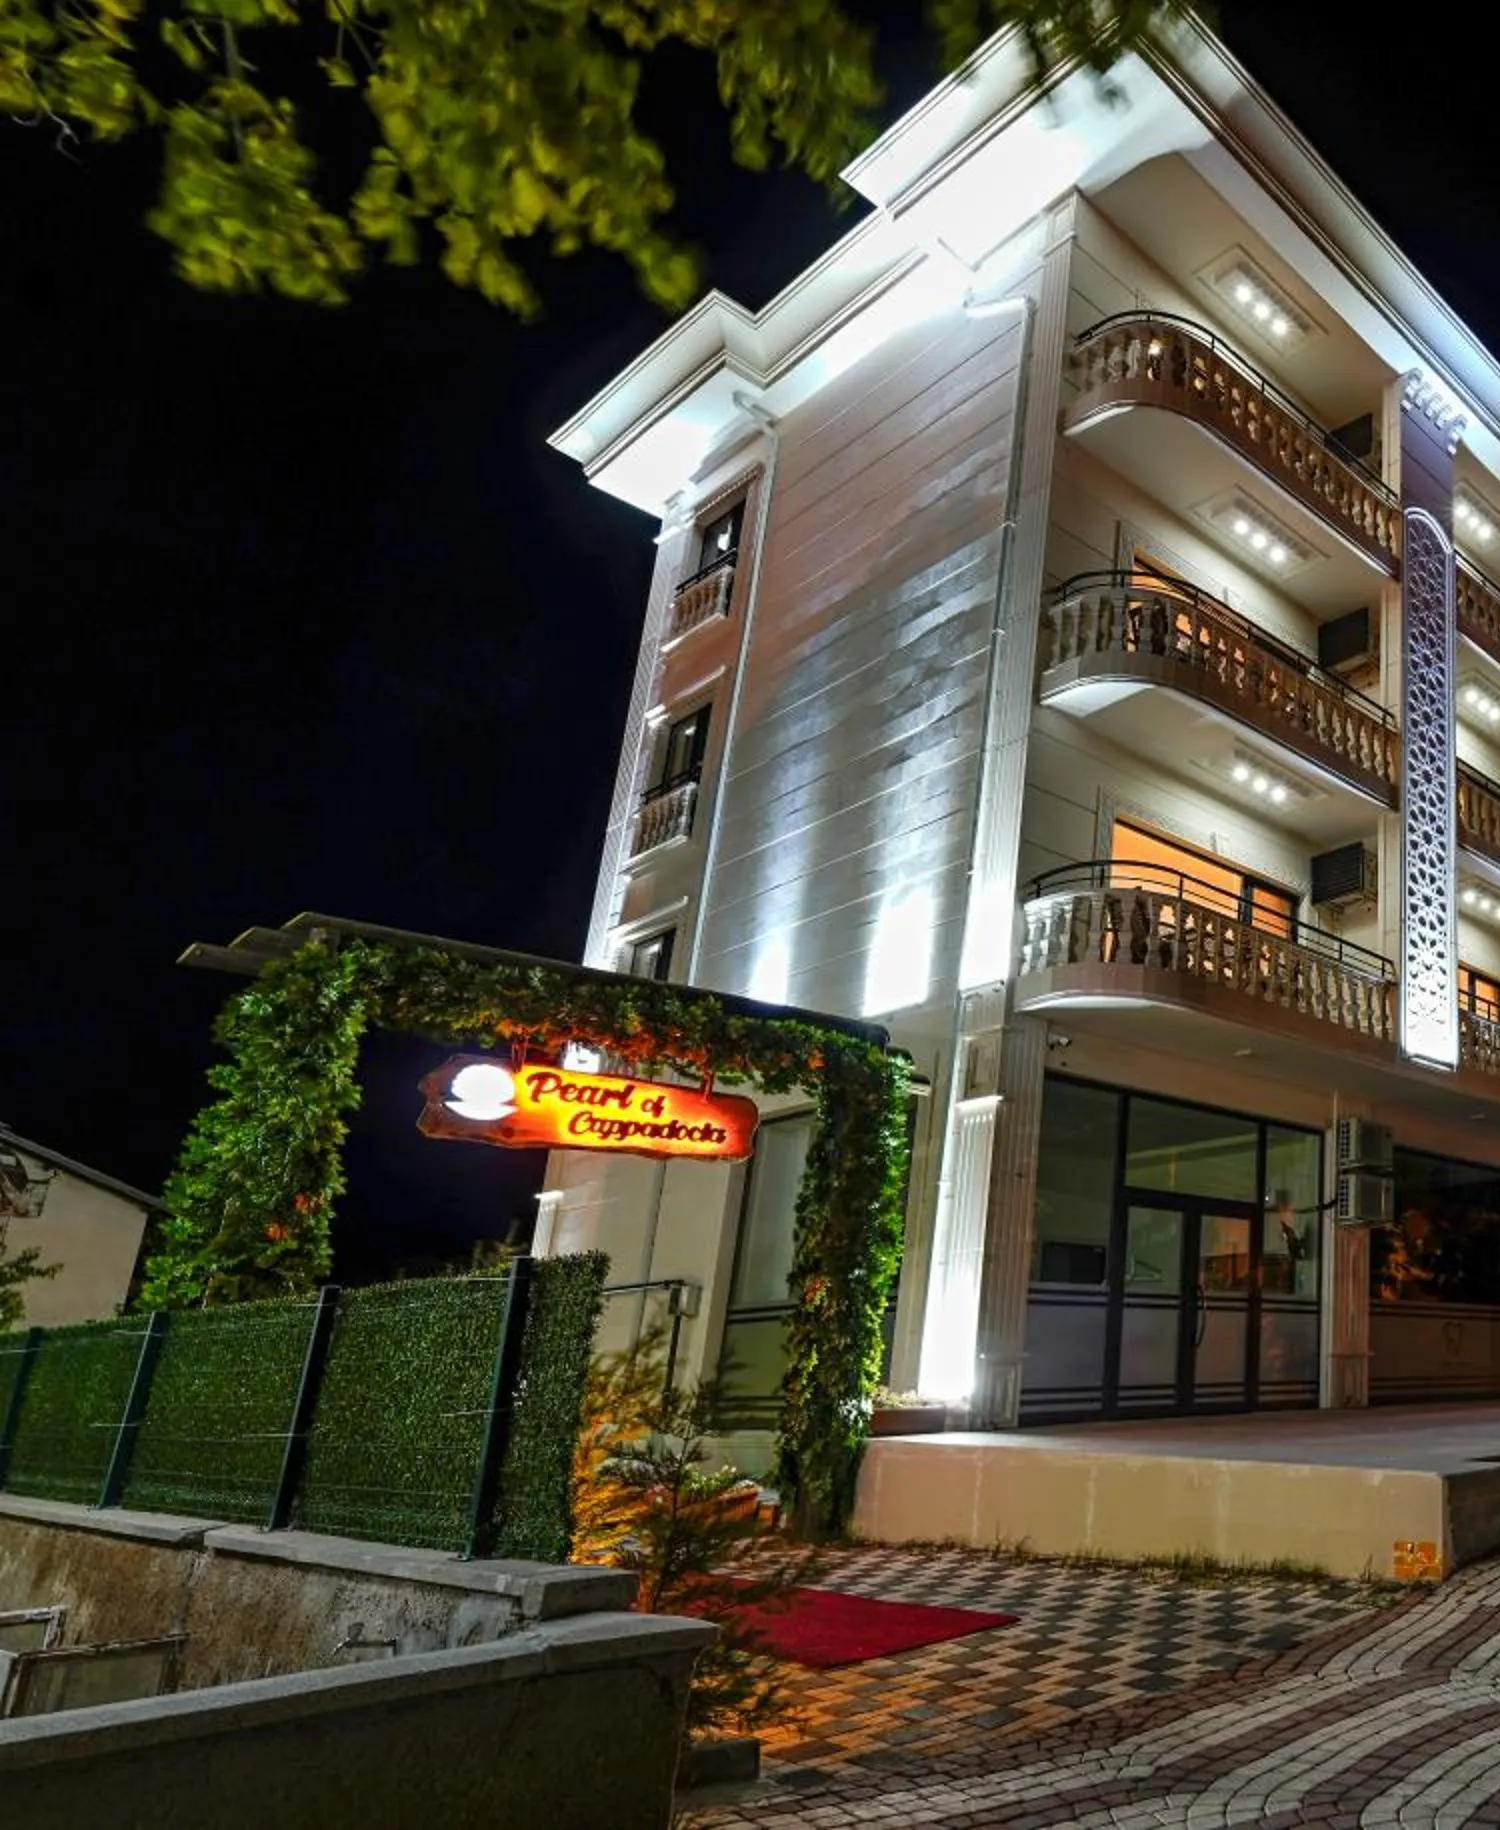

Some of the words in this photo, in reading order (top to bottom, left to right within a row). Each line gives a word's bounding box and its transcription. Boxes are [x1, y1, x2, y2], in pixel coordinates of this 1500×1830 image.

[526, 1071, 635, 1109] Pearl
[641, 1096, 666, 1117] of
[568, 1110, 727, 1144] Cappadocia
